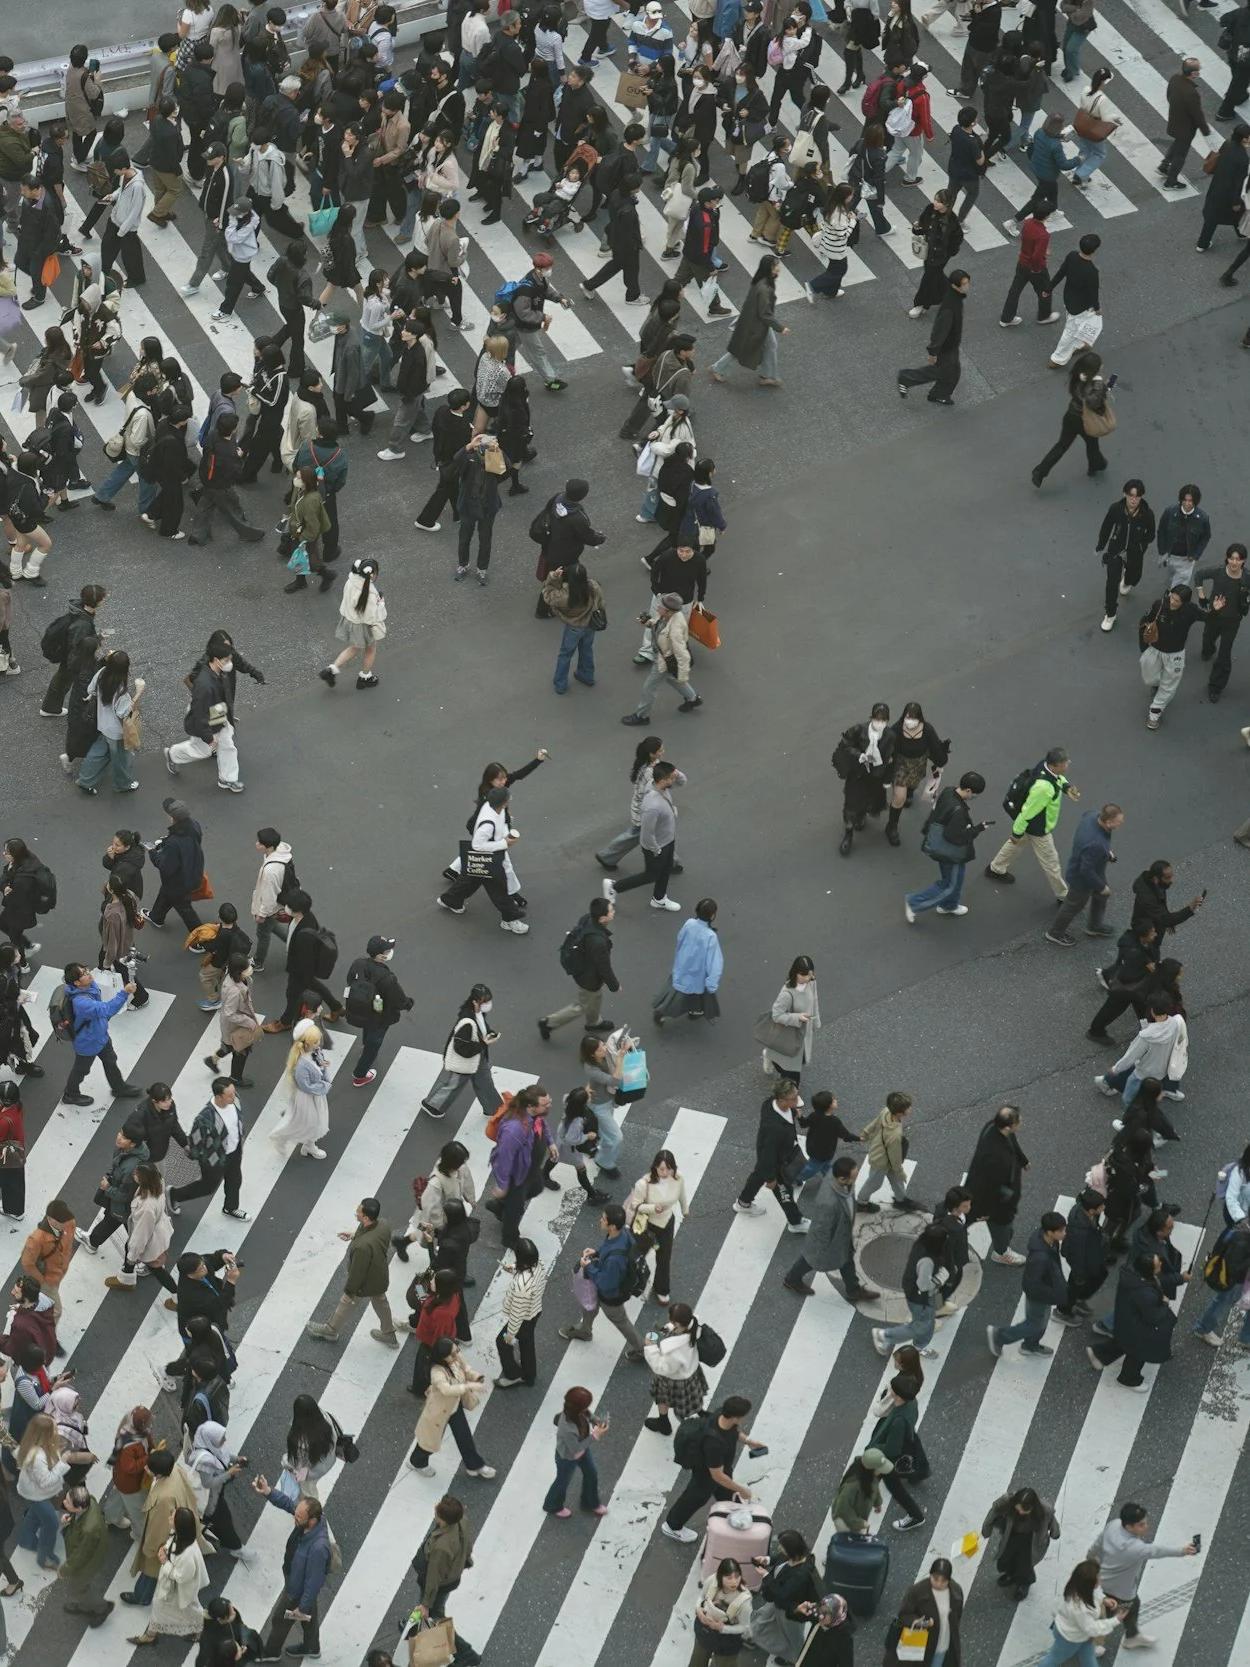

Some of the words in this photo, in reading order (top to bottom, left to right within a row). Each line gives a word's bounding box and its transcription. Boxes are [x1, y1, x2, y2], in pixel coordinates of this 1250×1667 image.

[467, 855, 493, 863] Market
[467, 861, 485, 869] Lane
[466, 867, 489, 875] Coffee
